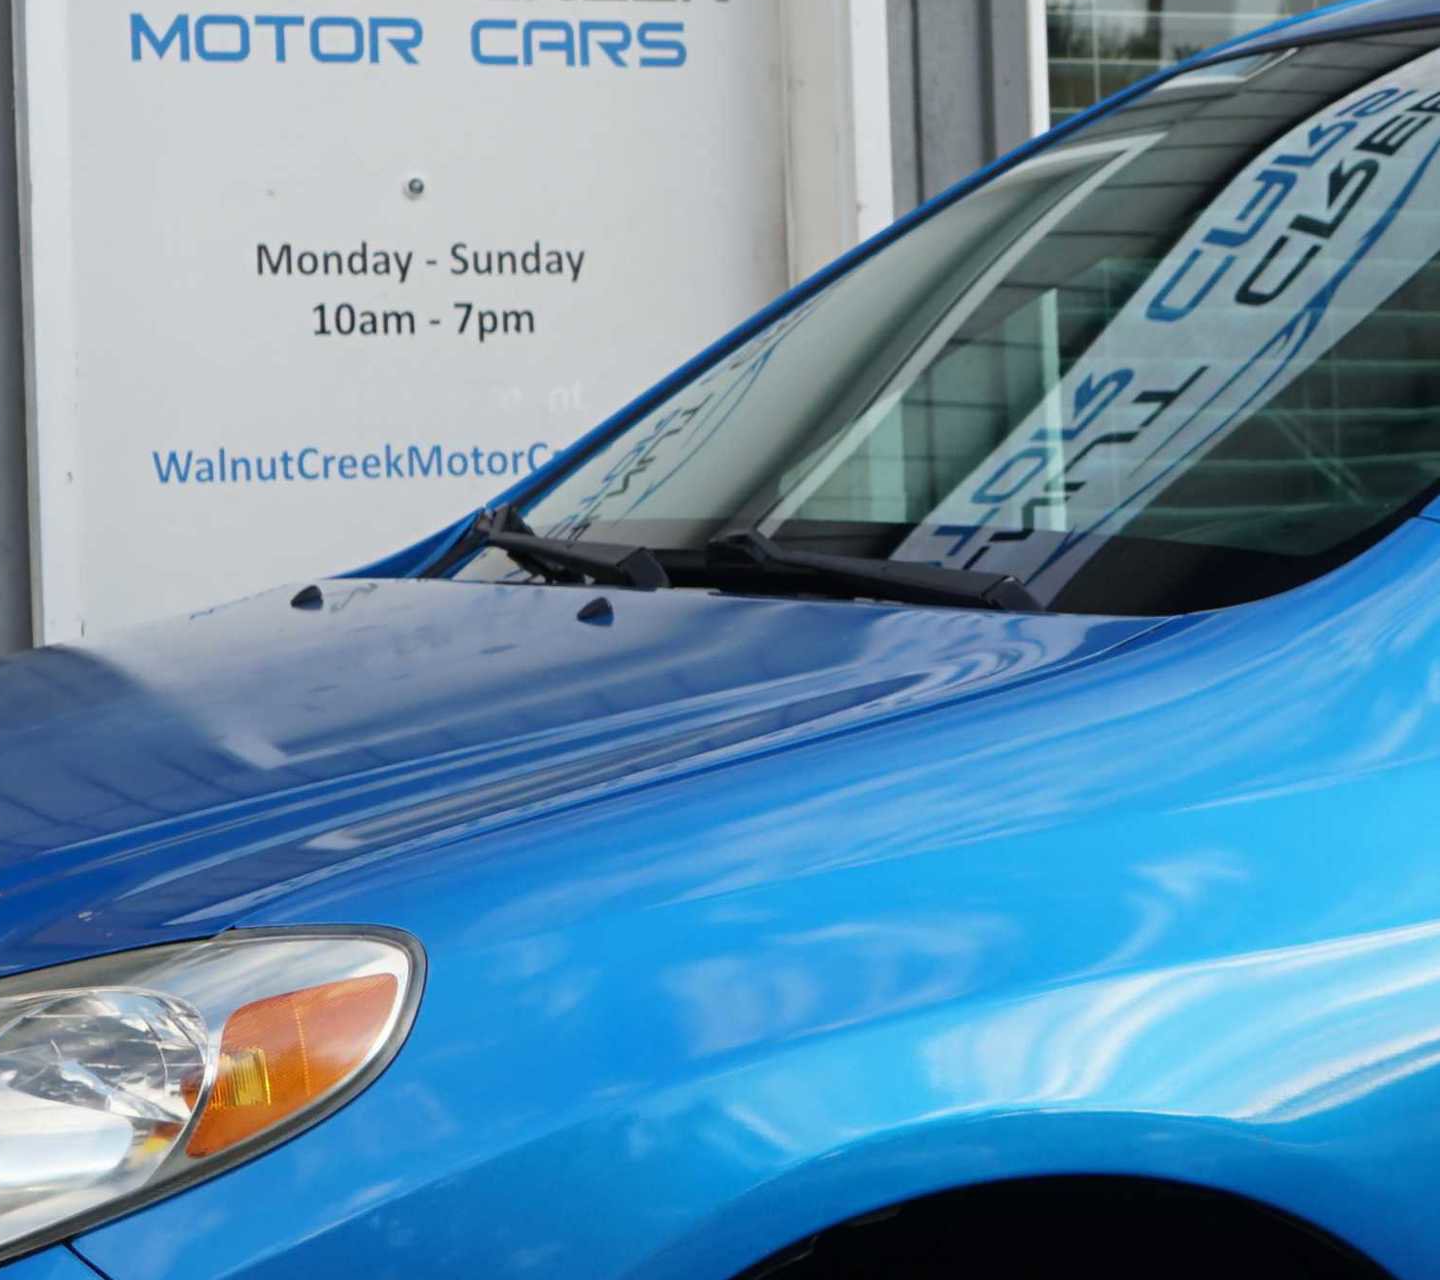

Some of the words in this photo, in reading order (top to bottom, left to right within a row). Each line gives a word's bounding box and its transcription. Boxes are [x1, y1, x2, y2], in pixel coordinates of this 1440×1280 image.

[129, 11, 424, 65] MOTOR
[469, 18, 688, 69] CARS
[256, 241, 413, 284] Monday
[450, 240, 585, 283] Sunday
[313, 302, 416, 336] 10am
[453, 302, 535, 343] 7pm
[151, 441, 565, 485] WalnutCreekMotorC
